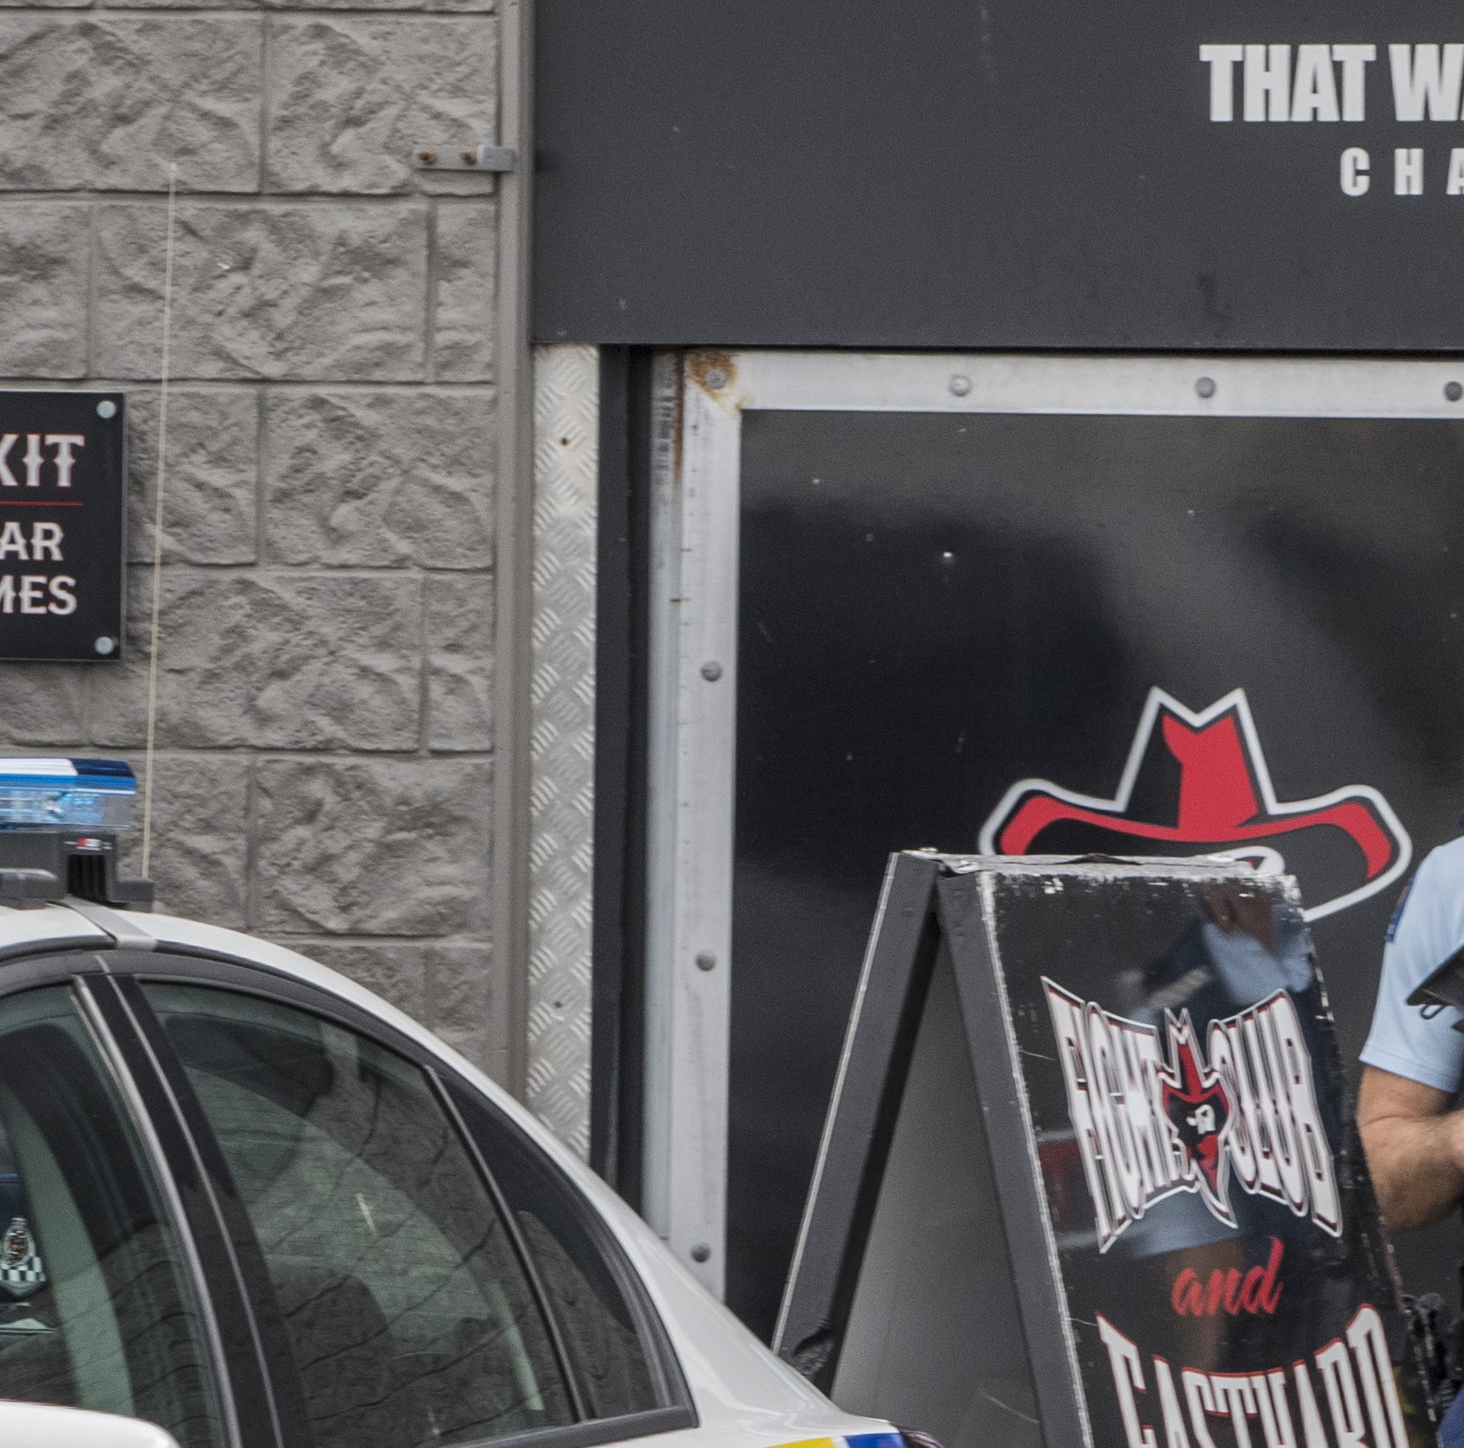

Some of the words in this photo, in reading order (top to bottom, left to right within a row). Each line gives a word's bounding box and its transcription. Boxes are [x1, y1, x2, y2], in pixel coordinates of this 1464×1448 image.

[1199, 43, 1377, 123] THAT
[1206, 988, 1343, 1238] CLUB
[1171, 1236, 1286, 1317] and
